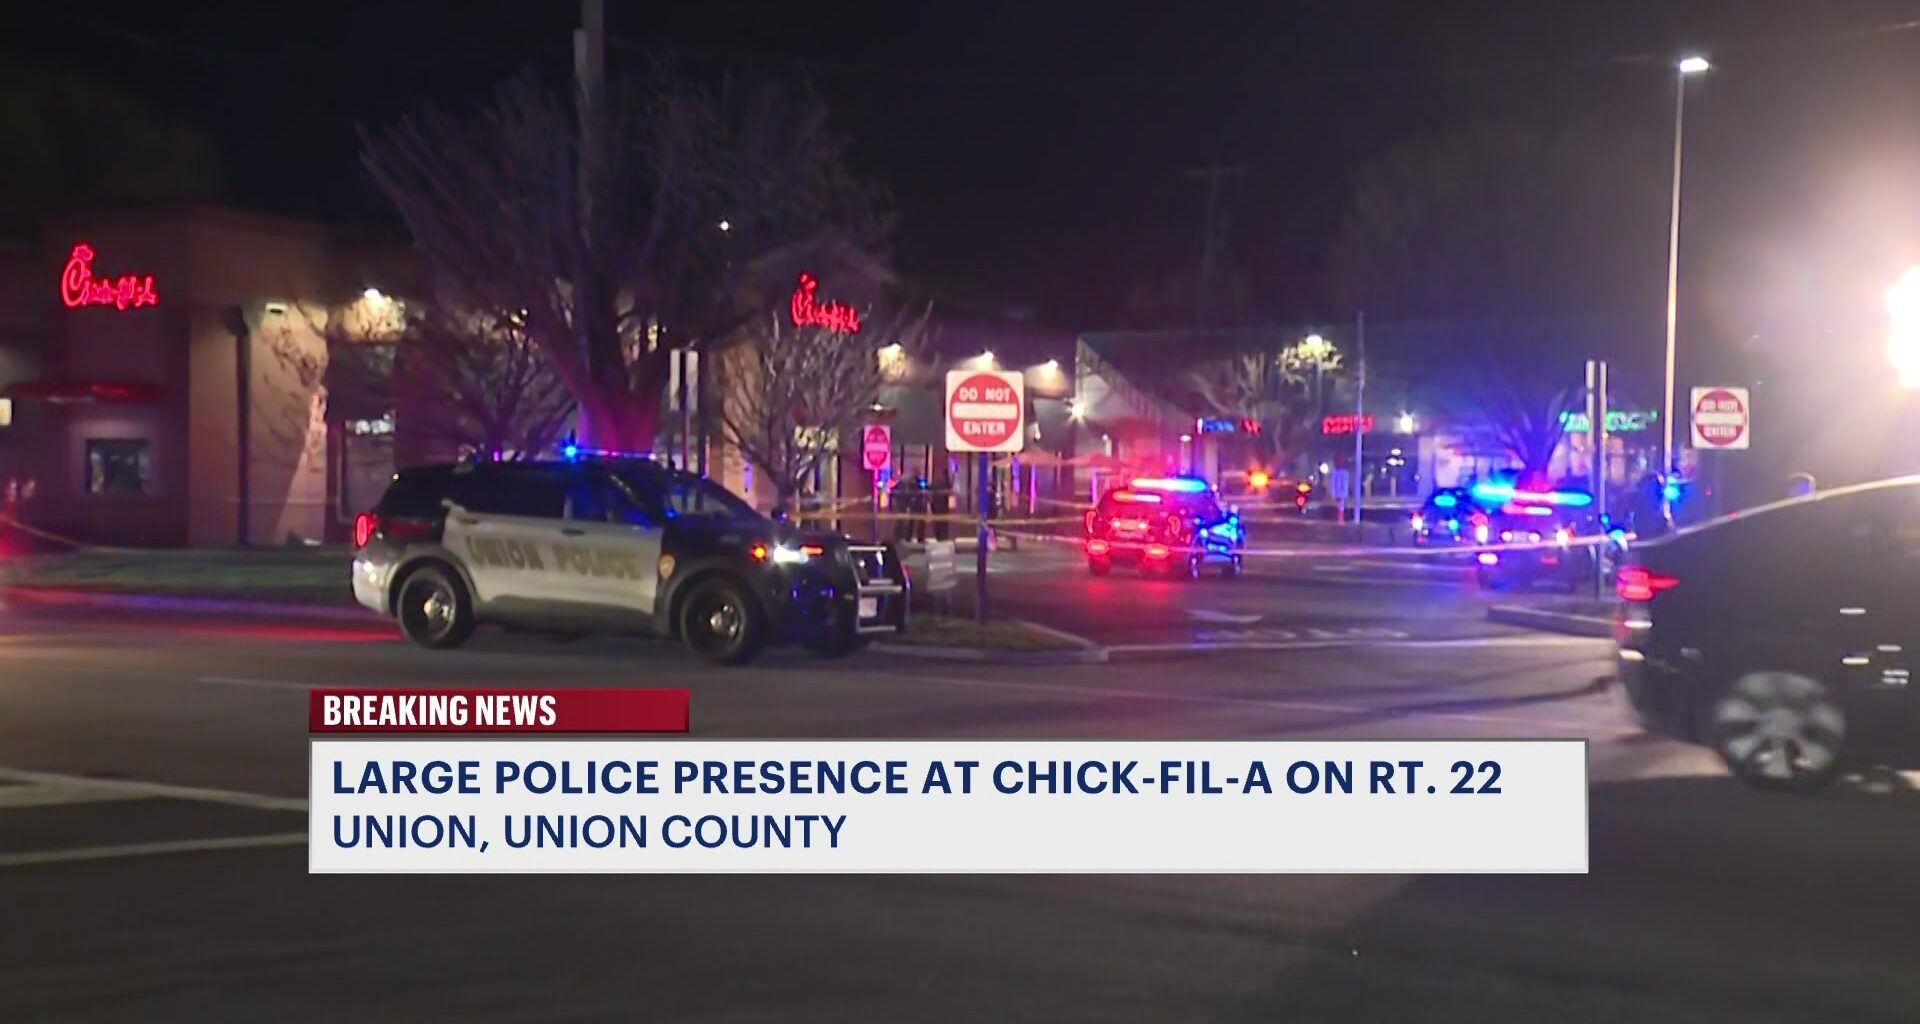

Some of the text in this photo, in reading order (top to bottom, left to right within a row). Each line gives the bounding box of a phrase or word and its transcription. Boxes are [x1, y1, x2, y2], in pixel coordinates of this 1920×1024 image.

[959, 387, 1011, 402] DO NOT
[963, 421, 1005, 435] ENTER
[466, 535, 545, 570] UNION
